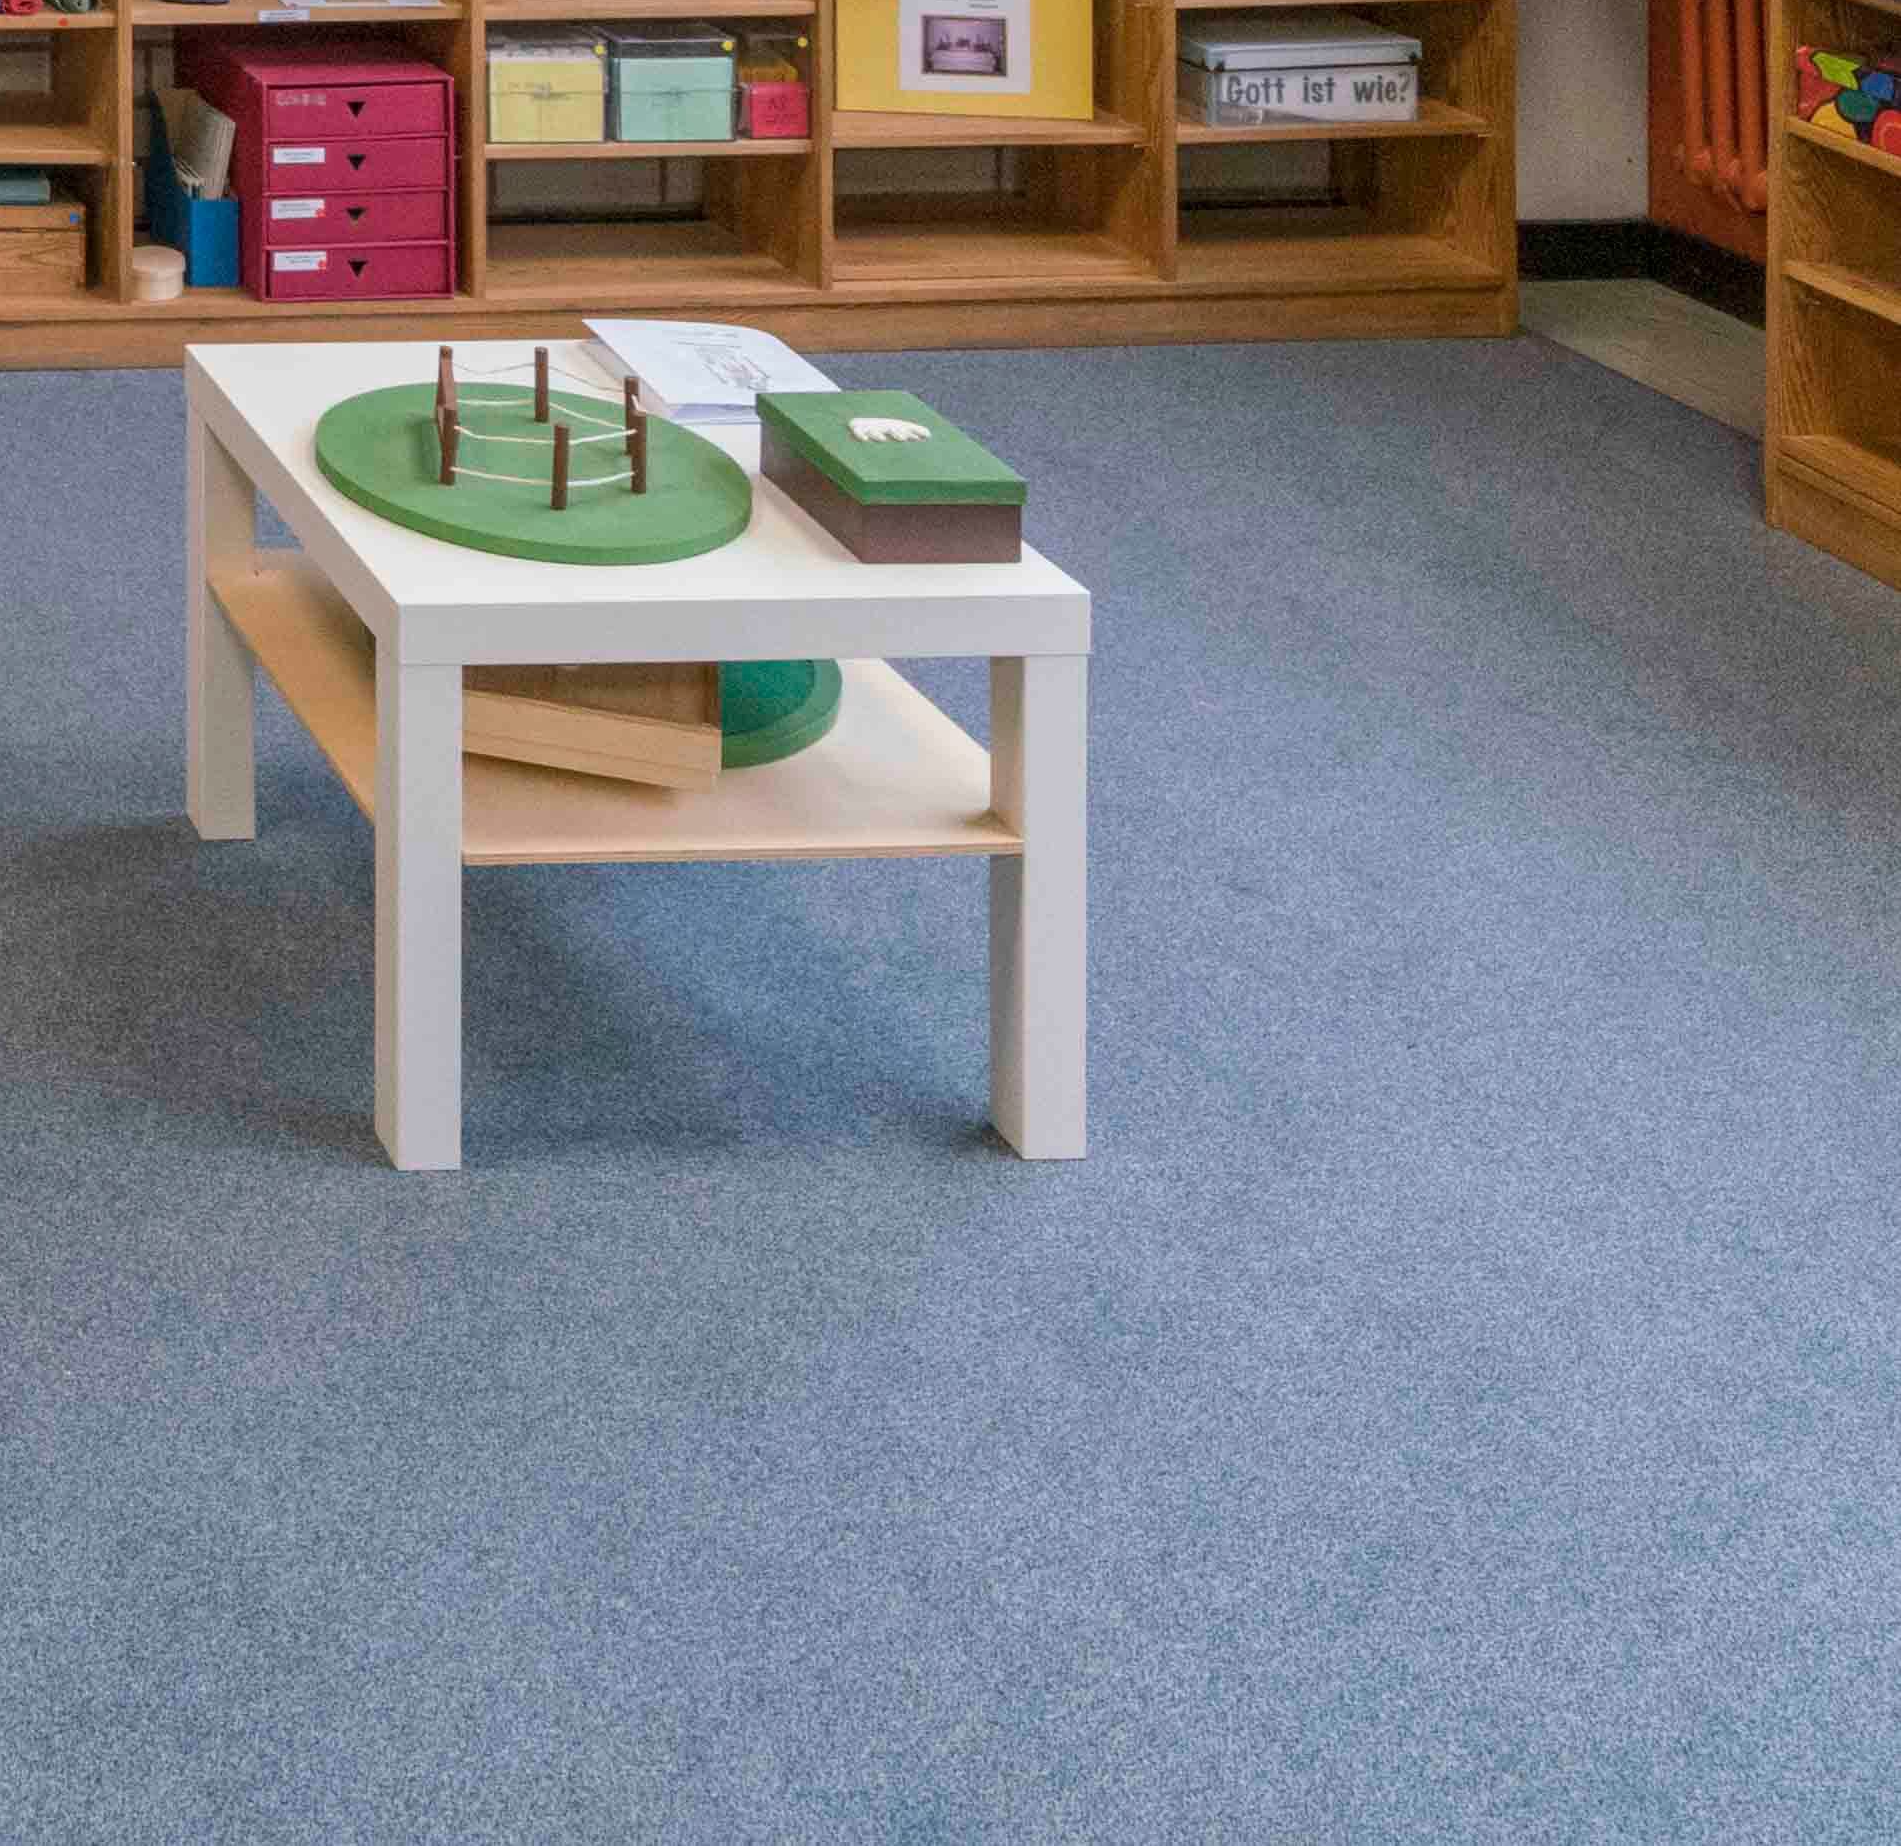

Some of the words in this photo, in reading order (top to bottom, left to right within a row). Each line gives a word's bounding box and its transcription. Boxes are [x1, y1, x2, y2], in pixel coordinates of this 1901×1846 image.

[1226, 75, 1286, 105] Gott
[1301, 75, 1337, 103] ist
[1352, 71, 1412, 104] wie?
